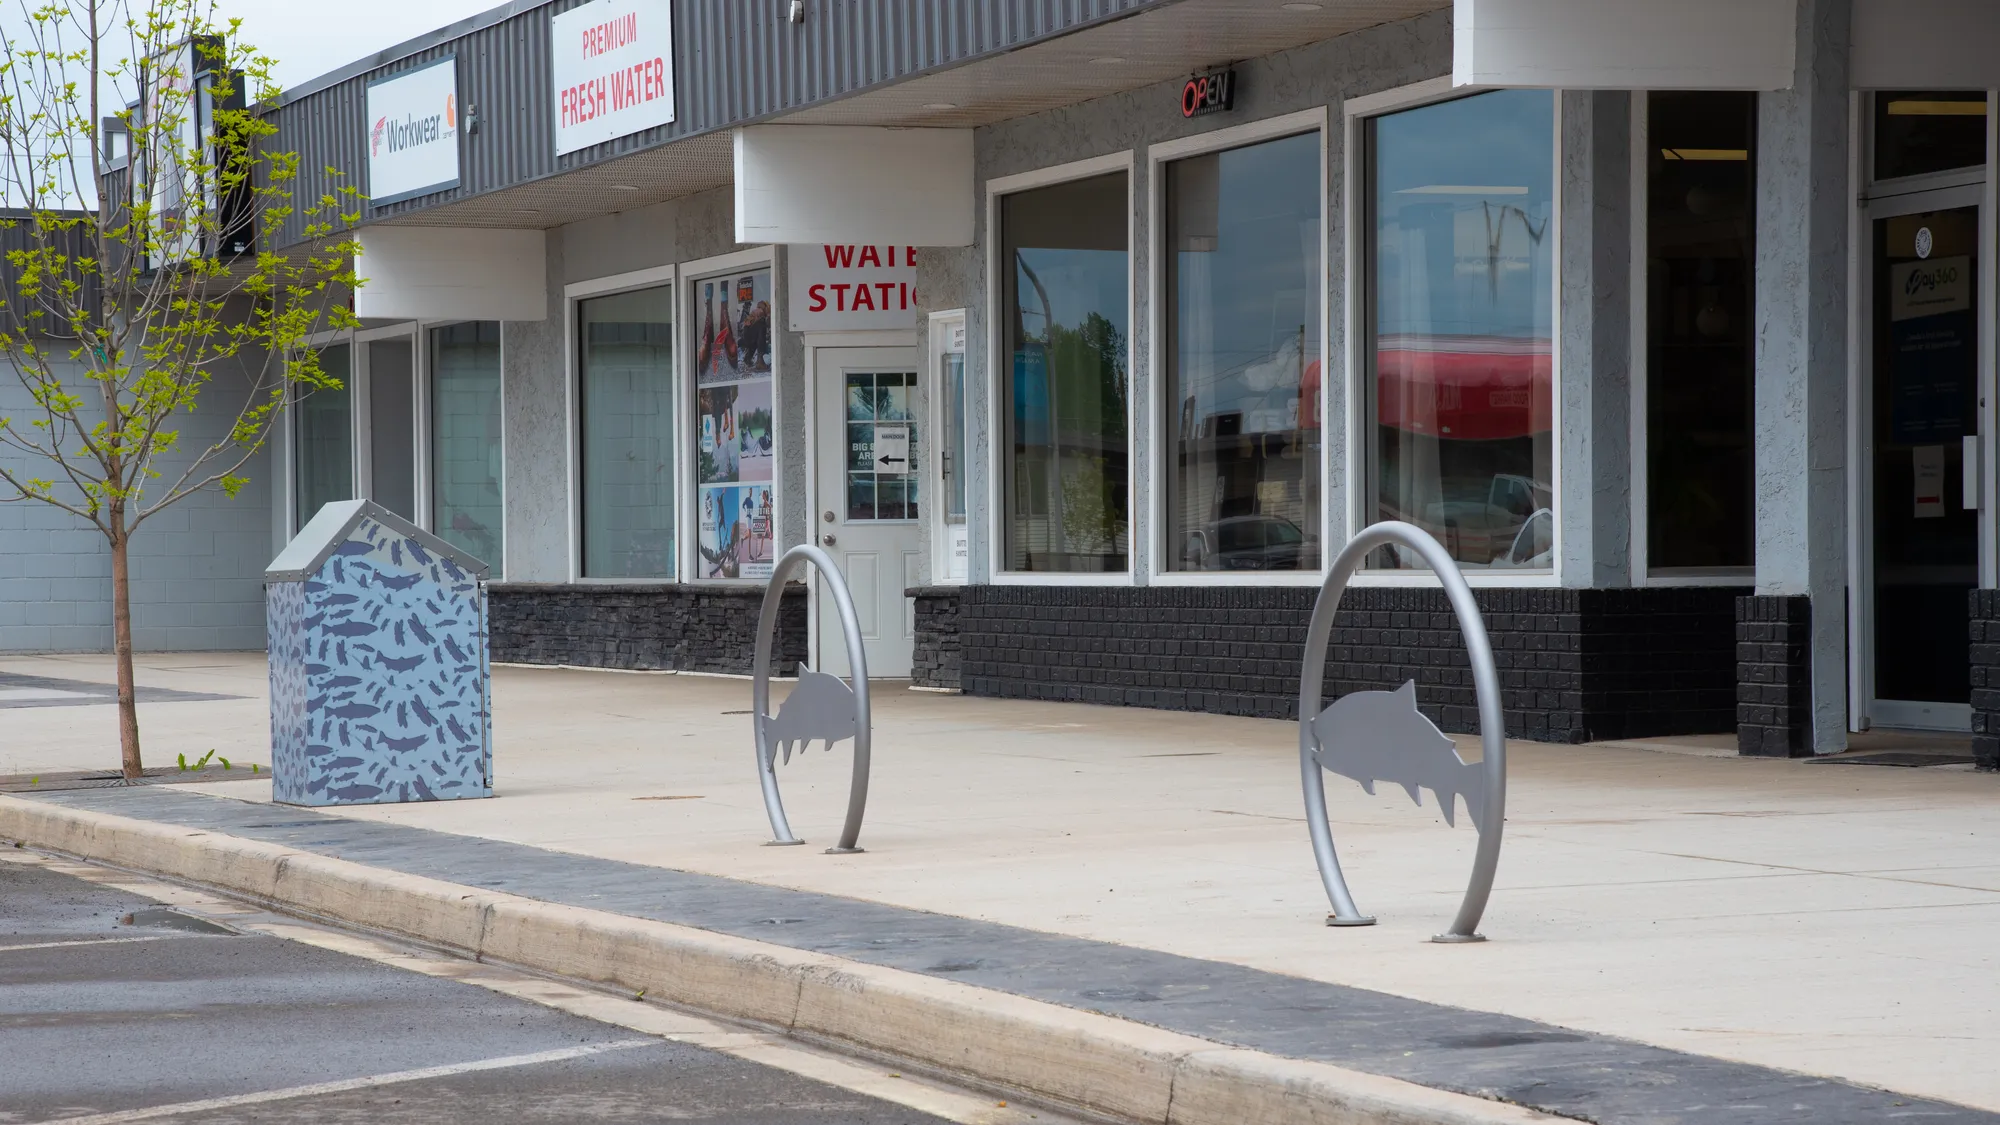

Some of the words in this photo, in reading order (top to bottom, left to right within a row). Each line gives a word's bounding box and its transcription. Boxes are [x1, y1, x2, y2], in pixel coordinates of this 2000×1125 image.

[583, 12, 637, 60] PREMIUM
[561, 76, 607, 129] FRESH
[611, 57, 665, 112] WATER
[1182, 72, 1228, 118] OPEN
[387, 113, 441, 154] Workwear
[808, 283, 917, 312] STATI
[852, 443, 868, 451] BIG
